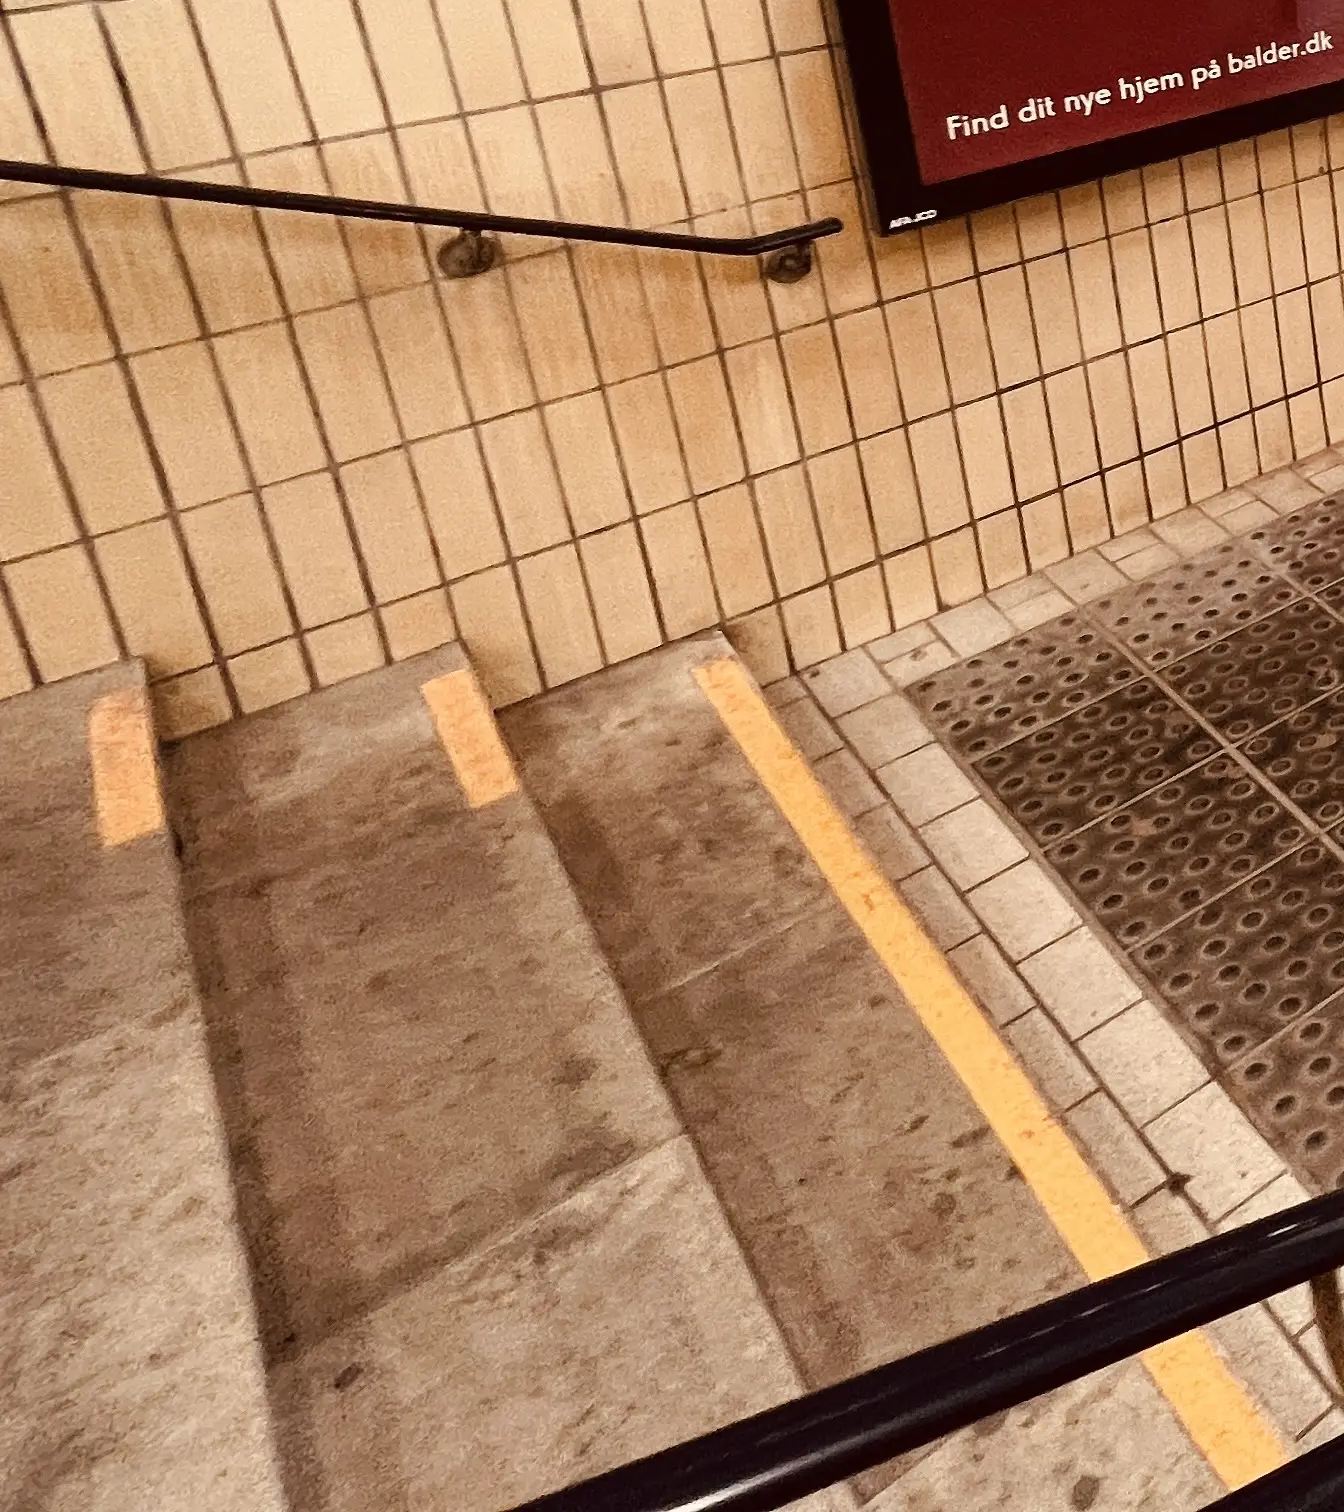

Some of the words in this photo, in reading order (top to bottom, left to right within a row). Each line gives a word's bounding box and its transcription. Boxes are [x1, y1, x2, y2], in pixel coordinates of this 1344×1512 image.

[945, 104, 1011, 141] Find
[1018, 98, 1057, 125] dit
[1064, 88, 1112, 117] nye
[1118, 72, 1185, 104] hjem
[1191, 59, 1222, 90] på
[1227, 30, 1334, 75] balder.dk
